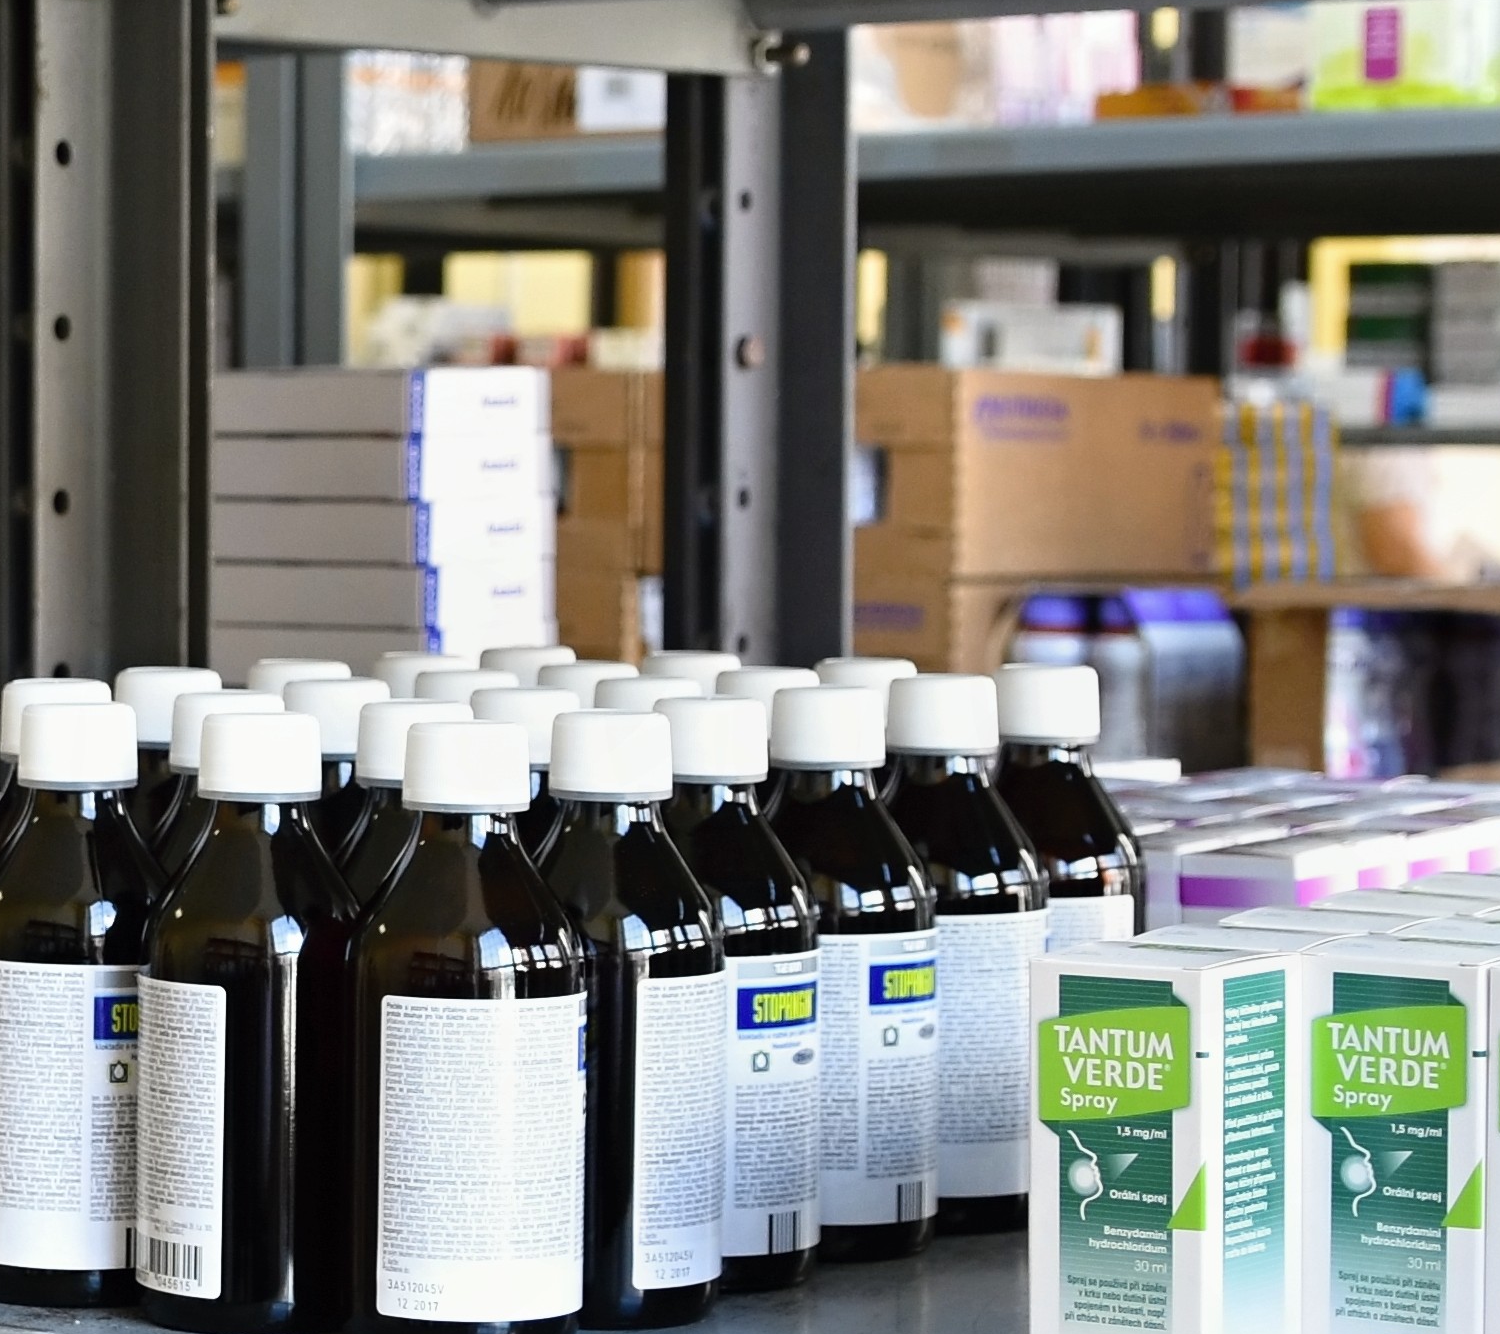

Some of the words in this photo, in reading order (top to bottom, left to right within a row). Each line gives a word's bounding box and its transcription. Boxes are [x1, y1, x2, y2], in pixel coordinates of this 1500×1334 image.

[1053, 1025, 1174, 1060] TANTUM
[1327, 1022, 1450, 1059] TANTUM
[1060, 1087, 1118, 1114] Spray
[1333, 1085, 1392, 1112] Spray
[1116, 1126, 1131, 1136] 1,5
[1133, 1129, 1167, 1139] mg/ml
[1390, 1124, 1405, 1134] 1,5
[1407, 1126, 1443, 1138] mg/ml
[1109, 1189, 1140, 1201] Orální
[1142, 1192, 1167, 1205] sprej
[1103, 1225, 1167, 1240] Benzydamini
[1089, 1238, 1167, 1254] hydrochloridum
[1134, 1260, 1150, 1273] 30
[1152, 1263, 1167, 1273] ml
[397, 1298, 408, 1309] 12
[414, 1299, 438, 1312] 2017
